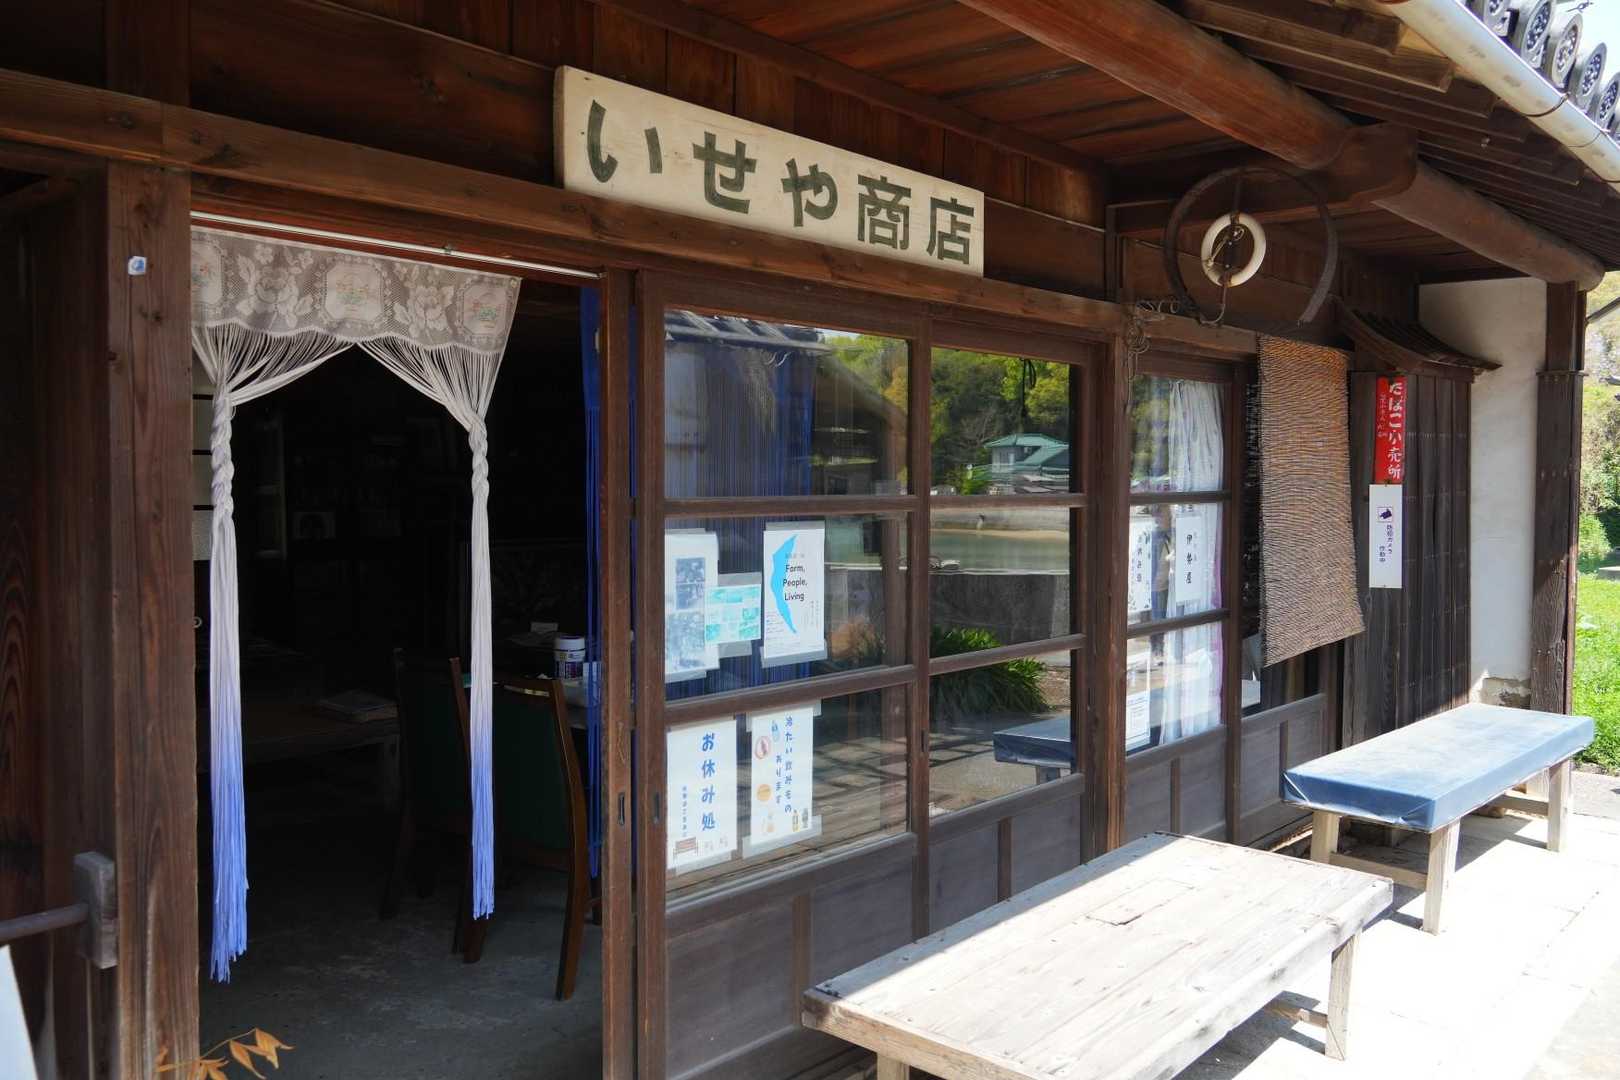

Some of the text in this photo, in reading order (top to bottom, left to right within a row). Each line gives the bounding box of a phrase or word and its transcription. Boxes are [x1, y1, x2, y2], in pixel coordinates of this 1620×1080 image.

[587, 98, 976, 266] いせや商店
[1387, 381, 1403, 480] たばこ小売所
[784, 592, 805, 602] Living
[701, 731, 716, 832] お休み処
